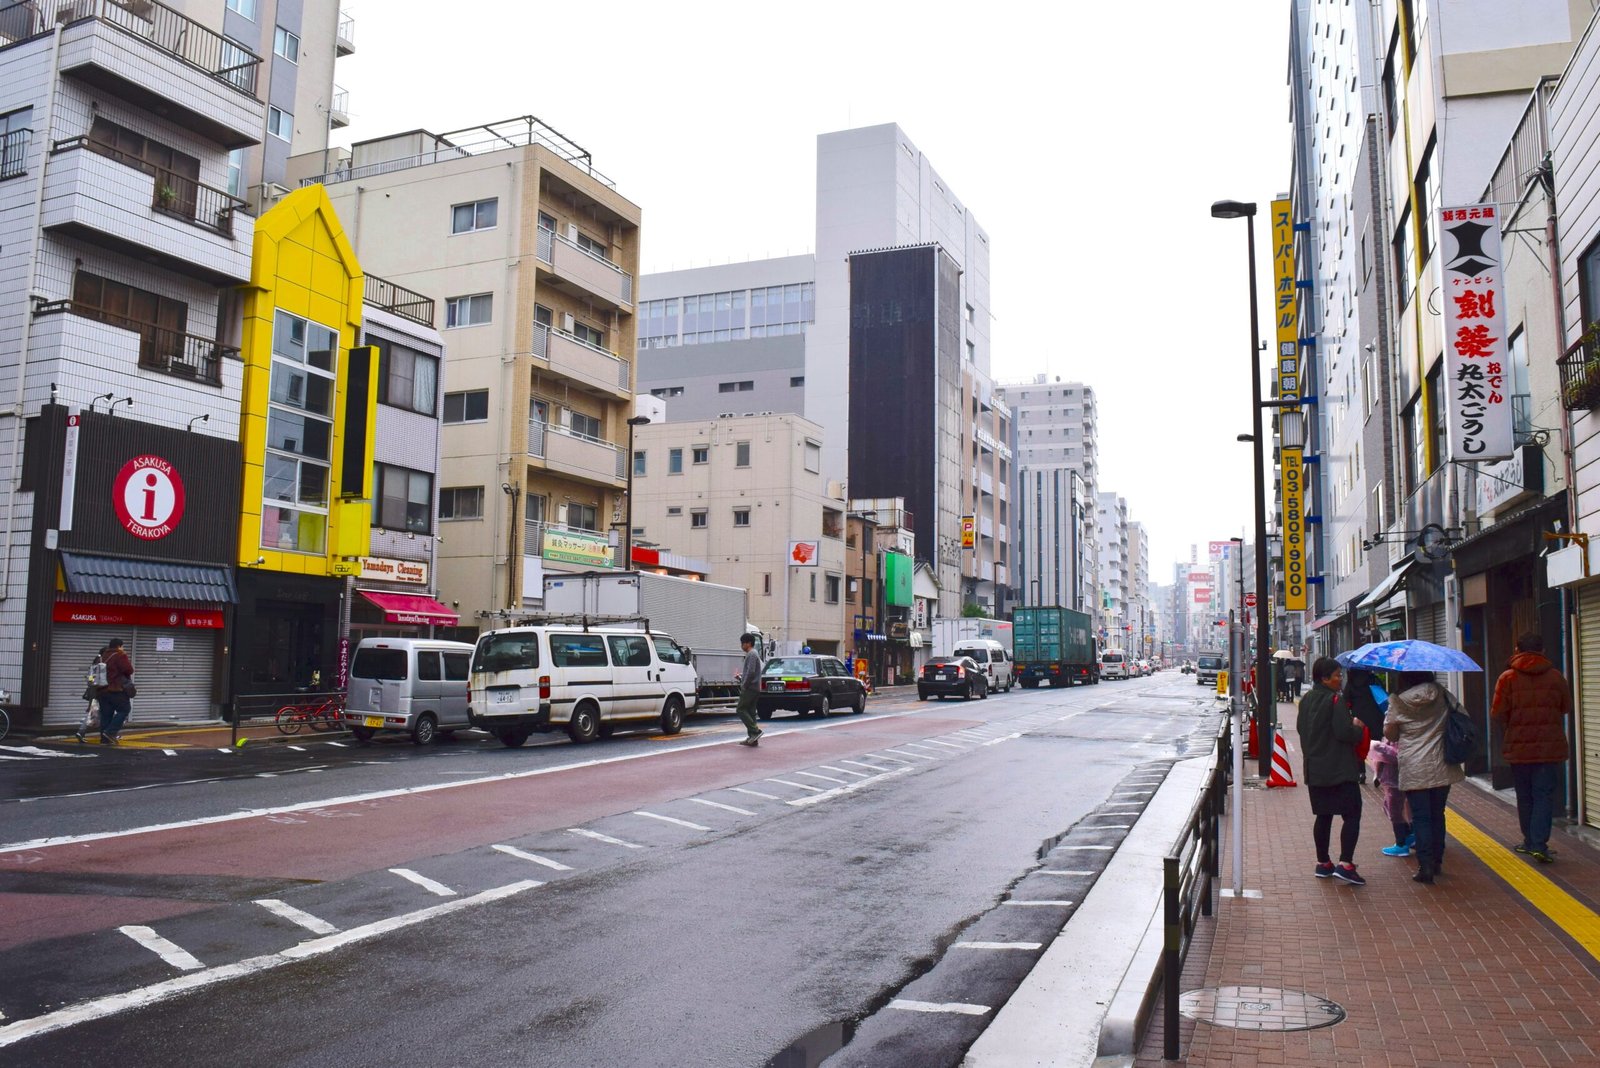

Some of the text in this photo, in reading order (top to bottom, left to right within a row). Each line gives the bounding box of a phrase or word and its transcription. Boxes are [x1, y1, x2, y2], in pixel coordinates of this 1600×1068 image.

[1276, 212, 1295, 329] スーパーホテル
[1487, 361, 1503, 404] おでん
[1457, 363, 1487, 454] 丸太ごうし
[133, 457, 172, 476] ASAKUSA
[1285, 456, 1299, 467] TEL
[126, 518, 172, 538] TERAKOYA
[964, 523, 973, 531] P
[362, 559, 423, 577] Yamadaya Cleaning
[71, 613, 97, 621] ASAKUSA
